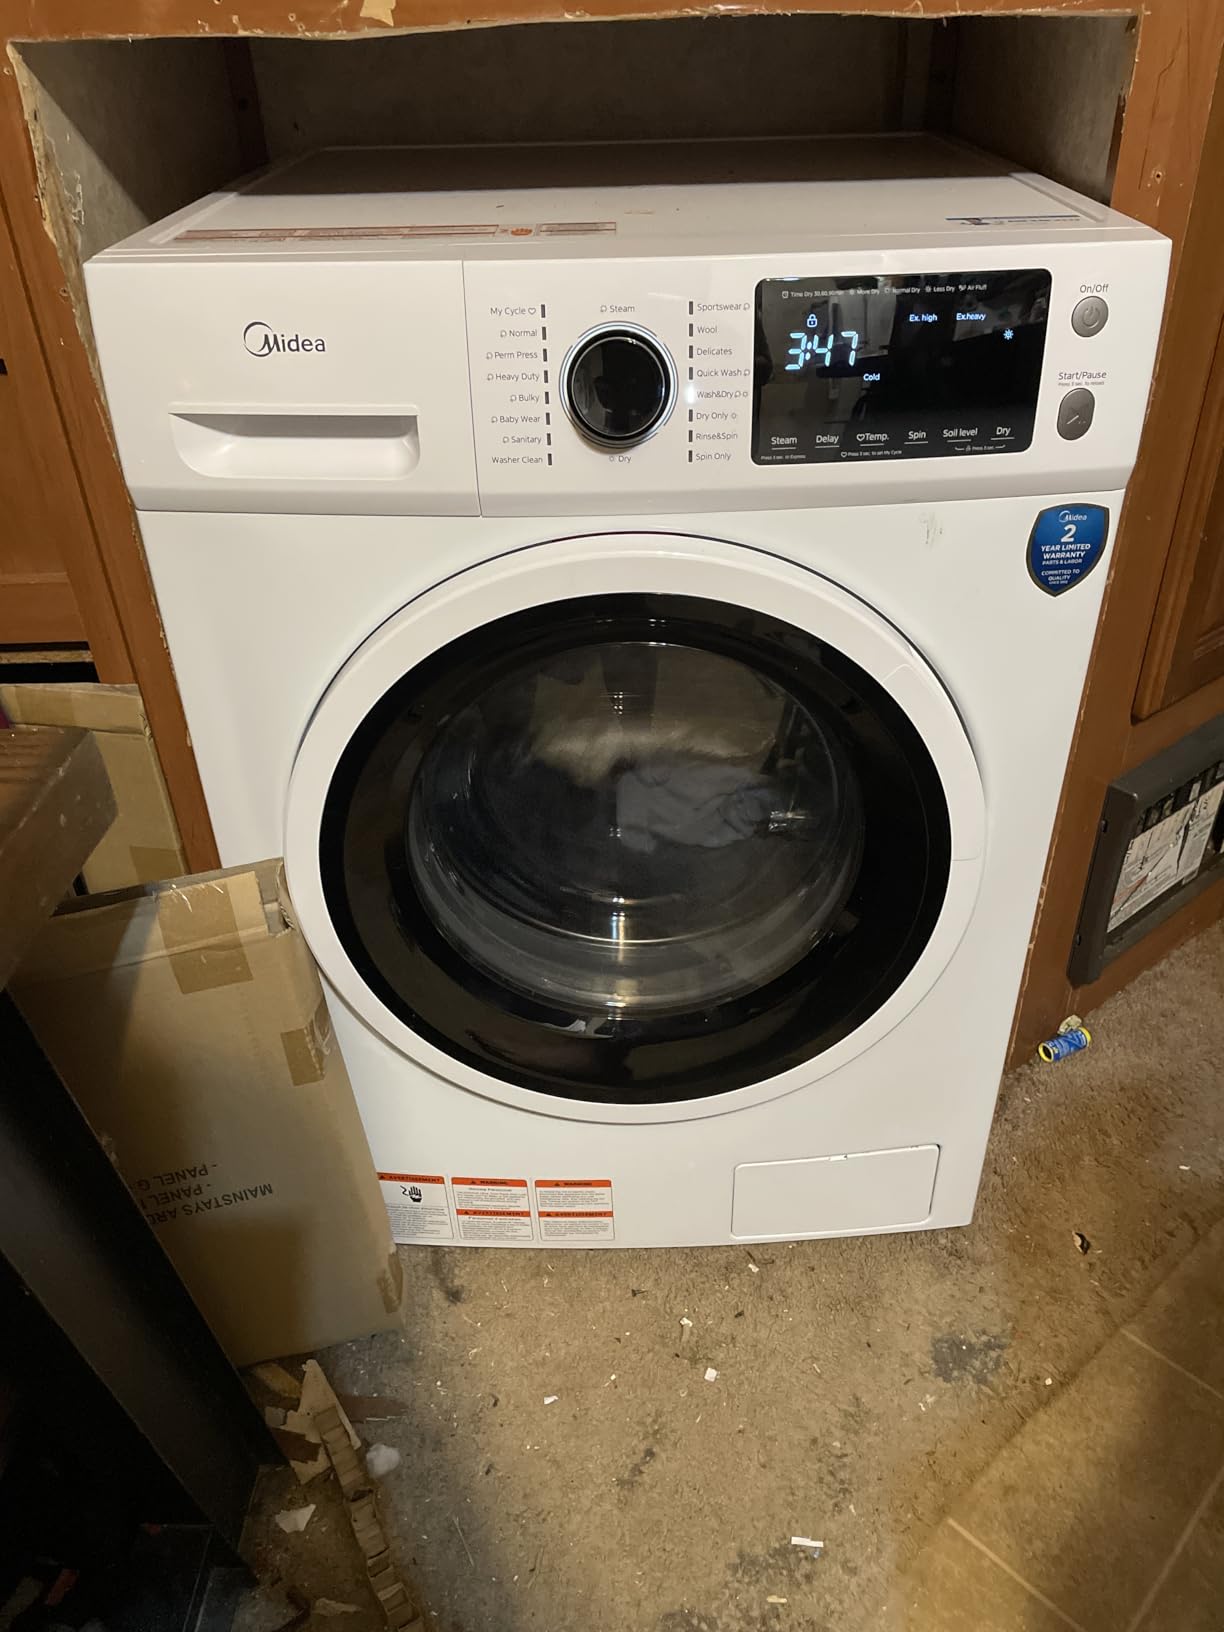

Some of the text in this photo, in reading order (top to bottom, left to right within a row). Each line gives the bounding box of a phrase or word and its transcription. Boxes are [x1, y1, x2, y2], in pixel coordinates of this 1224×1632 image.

[1079, 283, 1109, 294] On/Off
[490, 306, 526, 316] My Cycle
[609, 304, 635, 313] Steam
[697, 303, 742, 312] Sportswear
[921, 313, 938, 323] high
[509, 329, 538, 337] Normal
[697, 325, 718, 334] Wool
[243, 321, 326, 358] Midea
[494, 351, 538, 359] Perm Press
[696, 347, 733, 356] Delicates
[784, 331, 859, 371] 3:47
[495, 372, 540, 382] Heavy Duty
[696, 368, 742, 377] Quick Wash
[863, 373, 881, 381] Cold
[1058, 371, 1107, 381] Start/Pause
[518, 394, 540, 403] Bulky
[697, 390, 734, 399] Wash&Dry
[499, 415, 541, 424] Baby Wear
[696, 411, 728, 421] Dry Only
[696, 432, 738, 440] Rinse&Spin
[908, 430, 927, 440] Spin
[943, 427, 979, 437] Soil level
[996, 426, 1011, 437] Dry
[511, 435, 542, 445] Sanitary
[771, 435, 798, 445] Steam
[815, 434, 839, 444] Delay
[864, 432, 889, 442] Temp.
[491, 455, 544, 464] Washer Clean
[618, 455, 632, 465] Dry
[695, 452, 731, 461] Spin Only
[1058, 510, 1087, 523] Midea
[1060, 523, 1077, 543] 2
[1061, 543, 1091, 551] LIMITED
[1043, 551, 1086, 560] WARRANTY
[152, 1164, 209, 1187] PANEL
[150, 1184, 203, 1205] PANEL
[182, 1183, 273, 1216] MAINSTAYS
